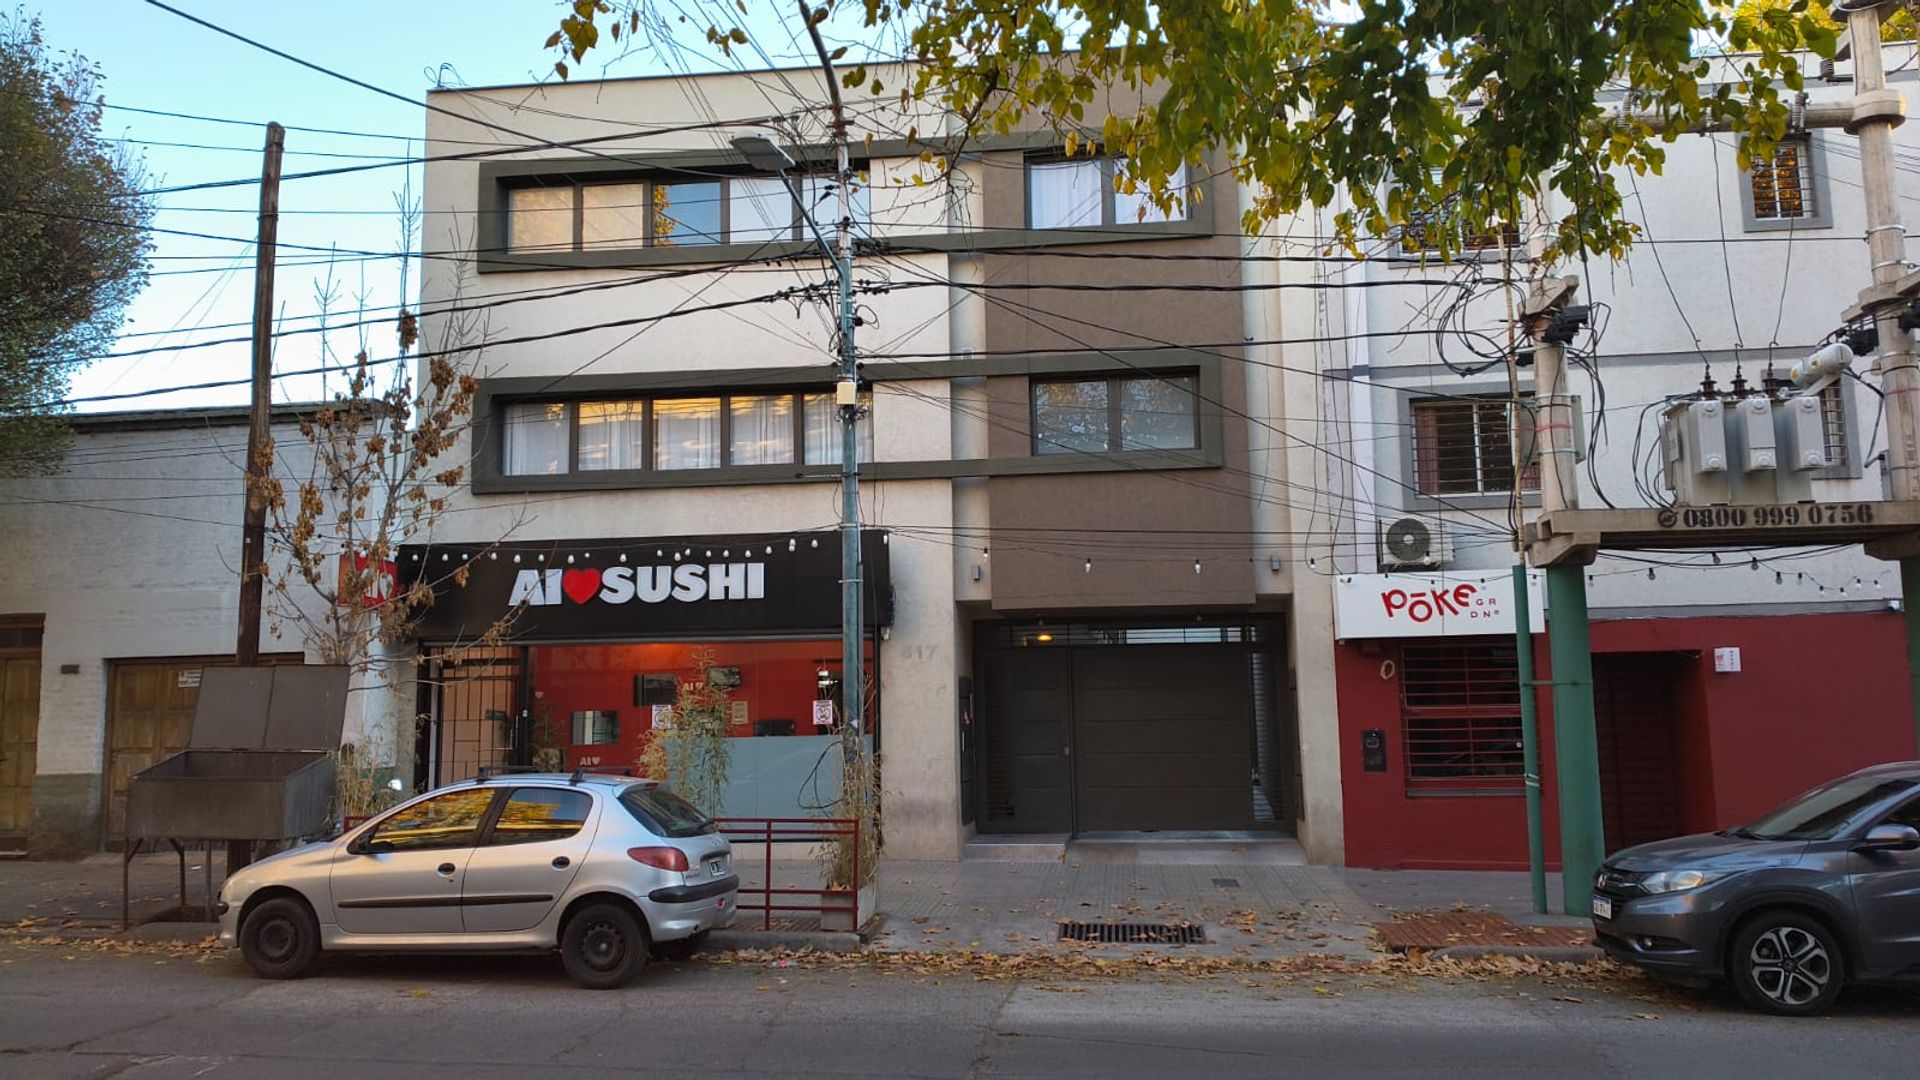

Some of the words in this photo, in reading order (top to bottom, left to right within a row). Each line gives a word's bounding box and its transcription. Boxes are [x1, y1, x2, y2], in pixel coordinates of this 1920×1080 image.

[1684, 508, 1747, 527] 0800
[1753, 507, 1800, 526] 999
[1808, 504, 1873, 525] 0756
[508, 569, 562, 606] AI
[600, 562, 765, 605] SUSHI
